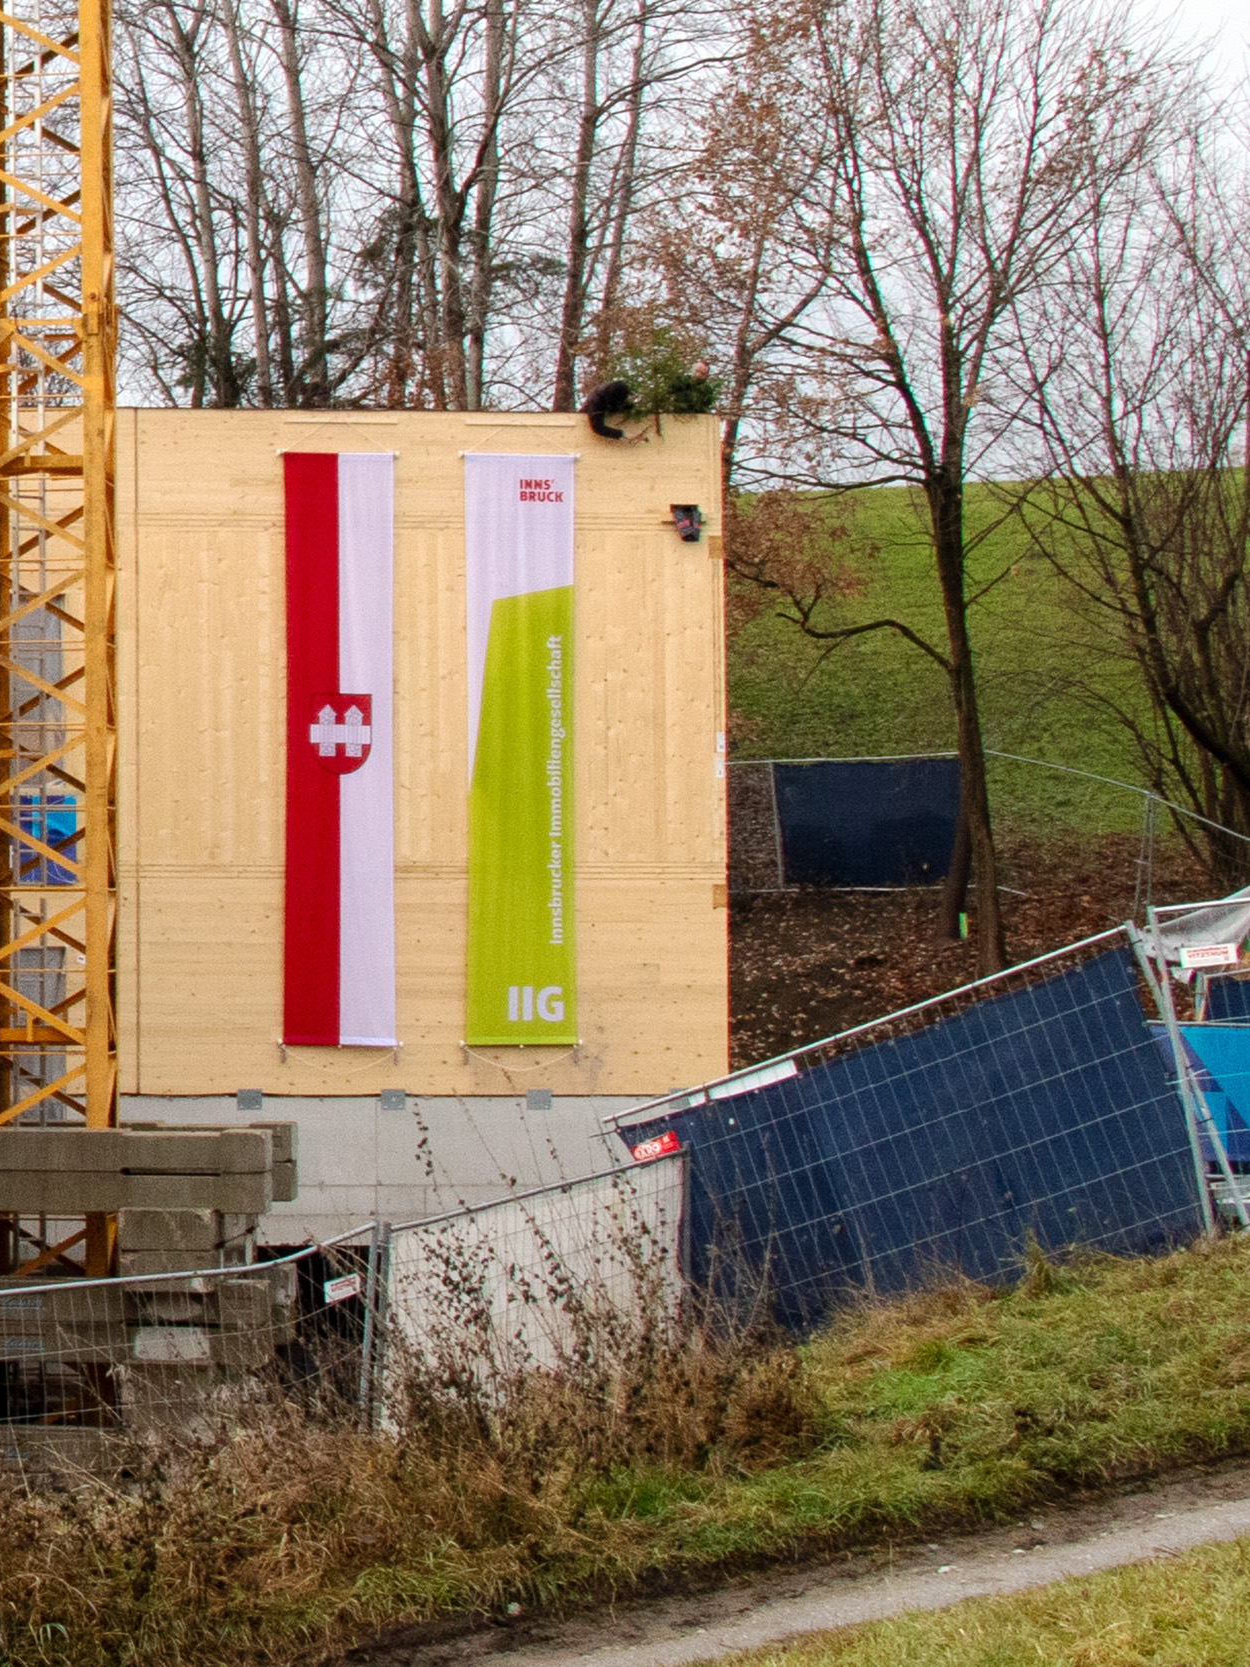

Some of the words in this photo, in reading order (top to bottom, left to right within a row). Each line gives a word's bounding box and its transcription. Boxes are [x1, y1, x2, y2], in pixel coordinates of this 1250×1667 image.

[519, 490, 564, 503] BRUCK
[546, 634, 566, 837] Immobiliengesellschaft
[547, 840, 563, 945] Innsbrucker
[507, 985, 566, 1023] IIG
